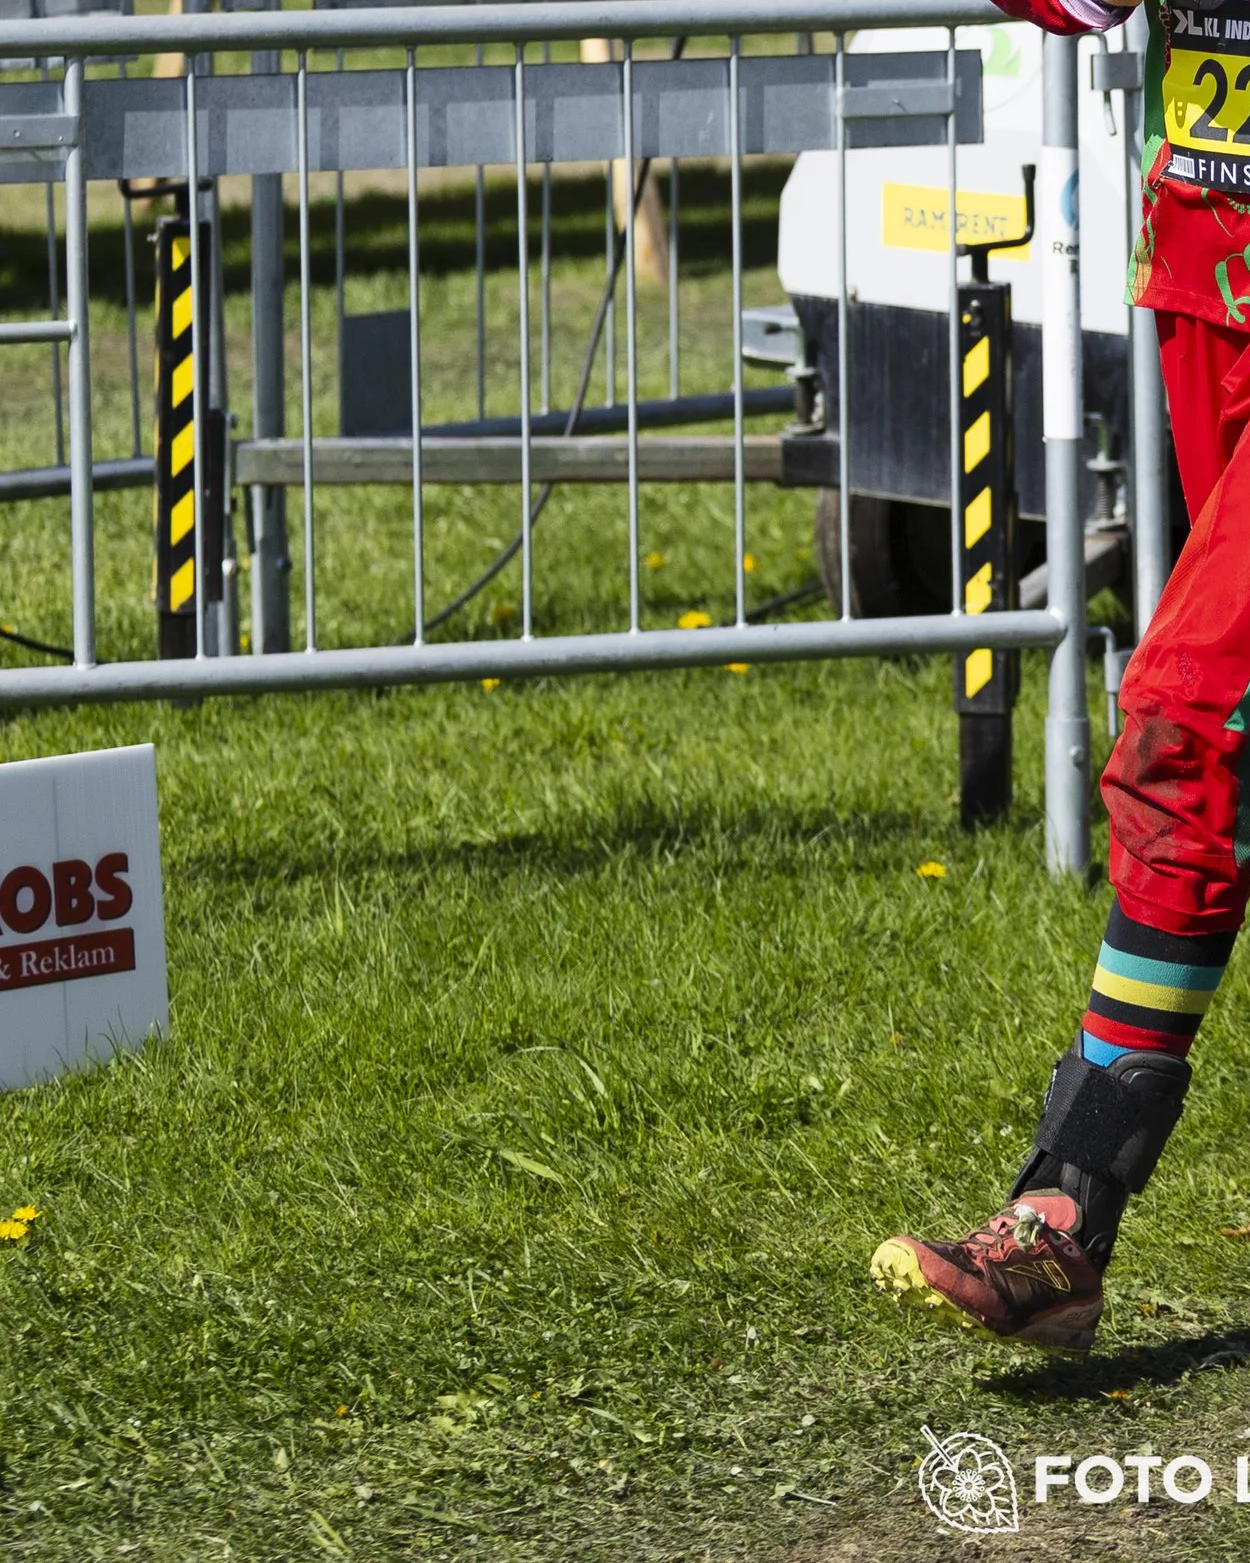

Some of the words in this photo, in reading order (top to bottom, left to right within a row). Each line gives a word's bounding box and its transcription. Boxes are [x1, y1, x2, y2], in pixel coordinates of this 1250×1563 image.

[1204, 17, 1220, 38] KL
[903, 207, 1008, 241] RAMRENT
[0, 852, 133, 935] OBS
[19, 944, 116, 978] Reklam
